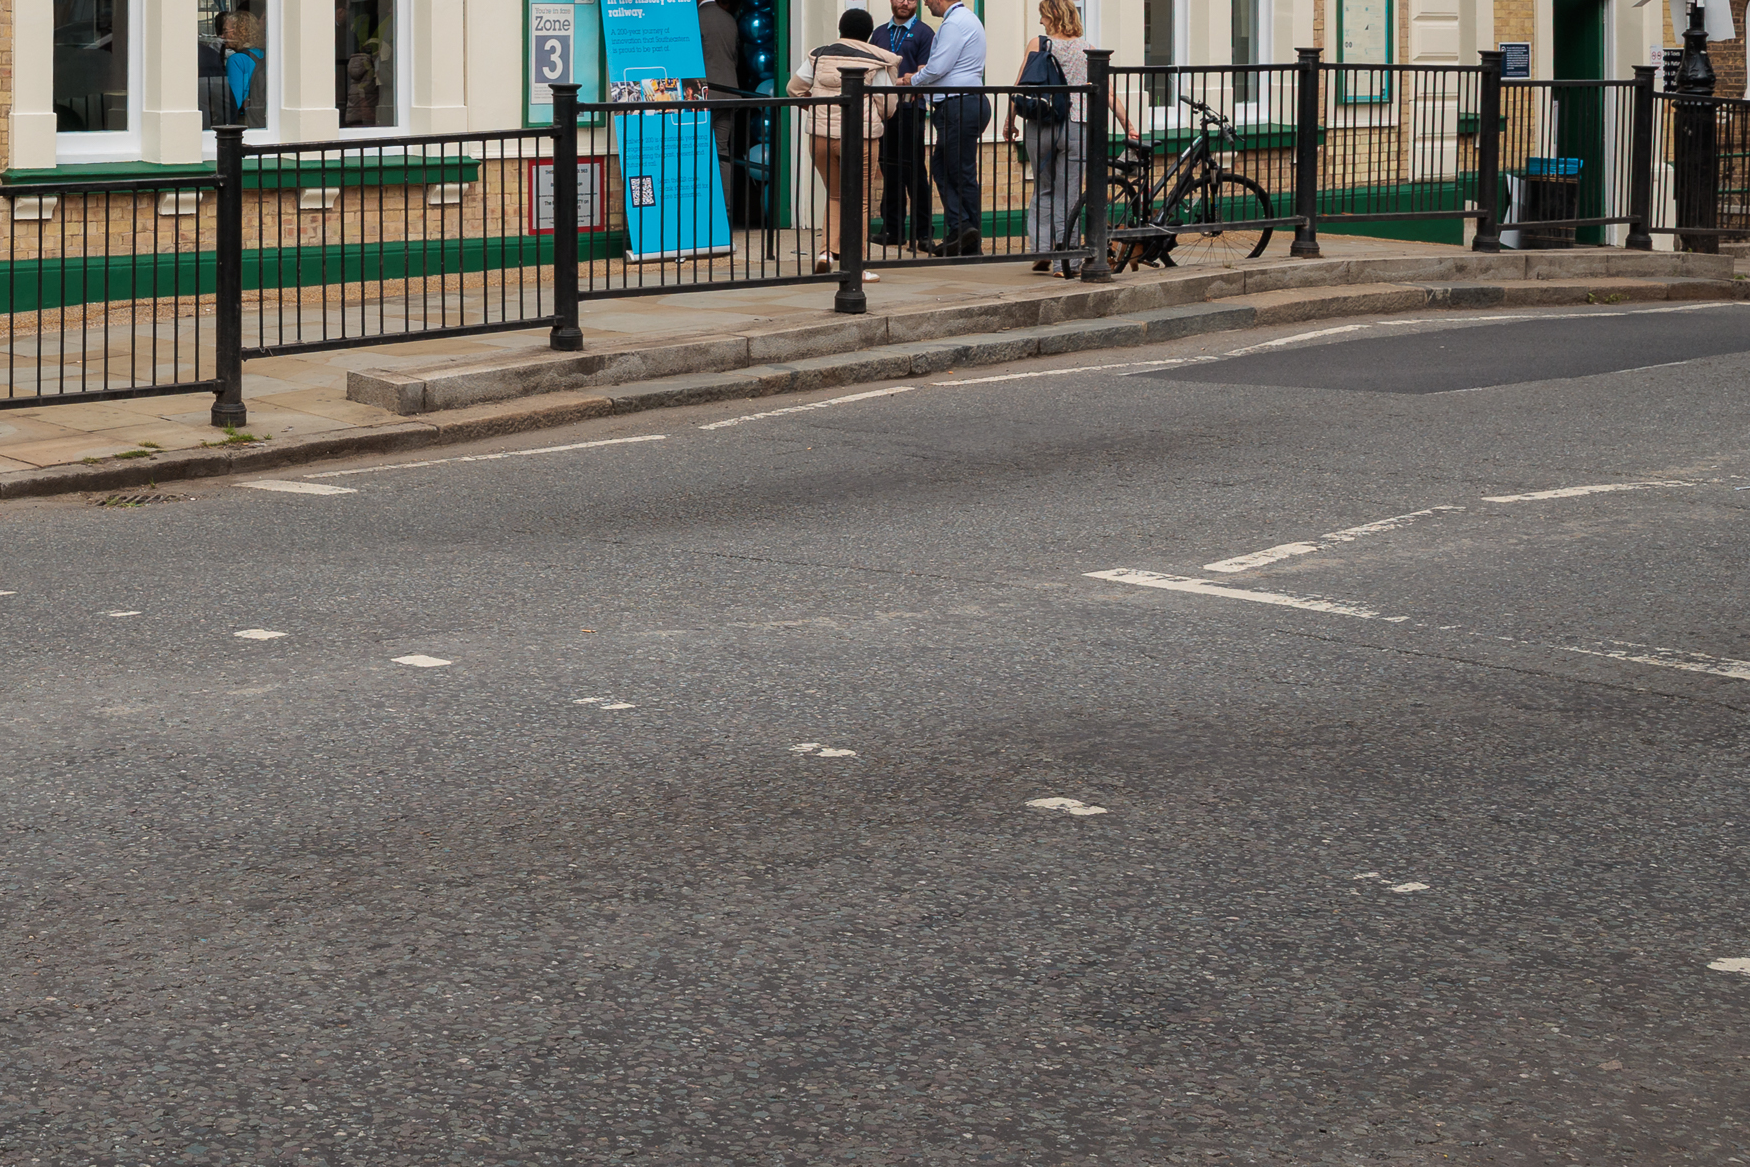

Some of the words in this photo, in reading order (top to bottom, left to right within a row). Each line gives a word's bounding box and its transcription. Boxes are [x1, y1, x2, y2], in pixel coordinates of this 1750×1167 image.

[608, 8, 645, 18] railway.
[535, 16, 570, 31] Zone
[542, 38, 563, 79] 3
